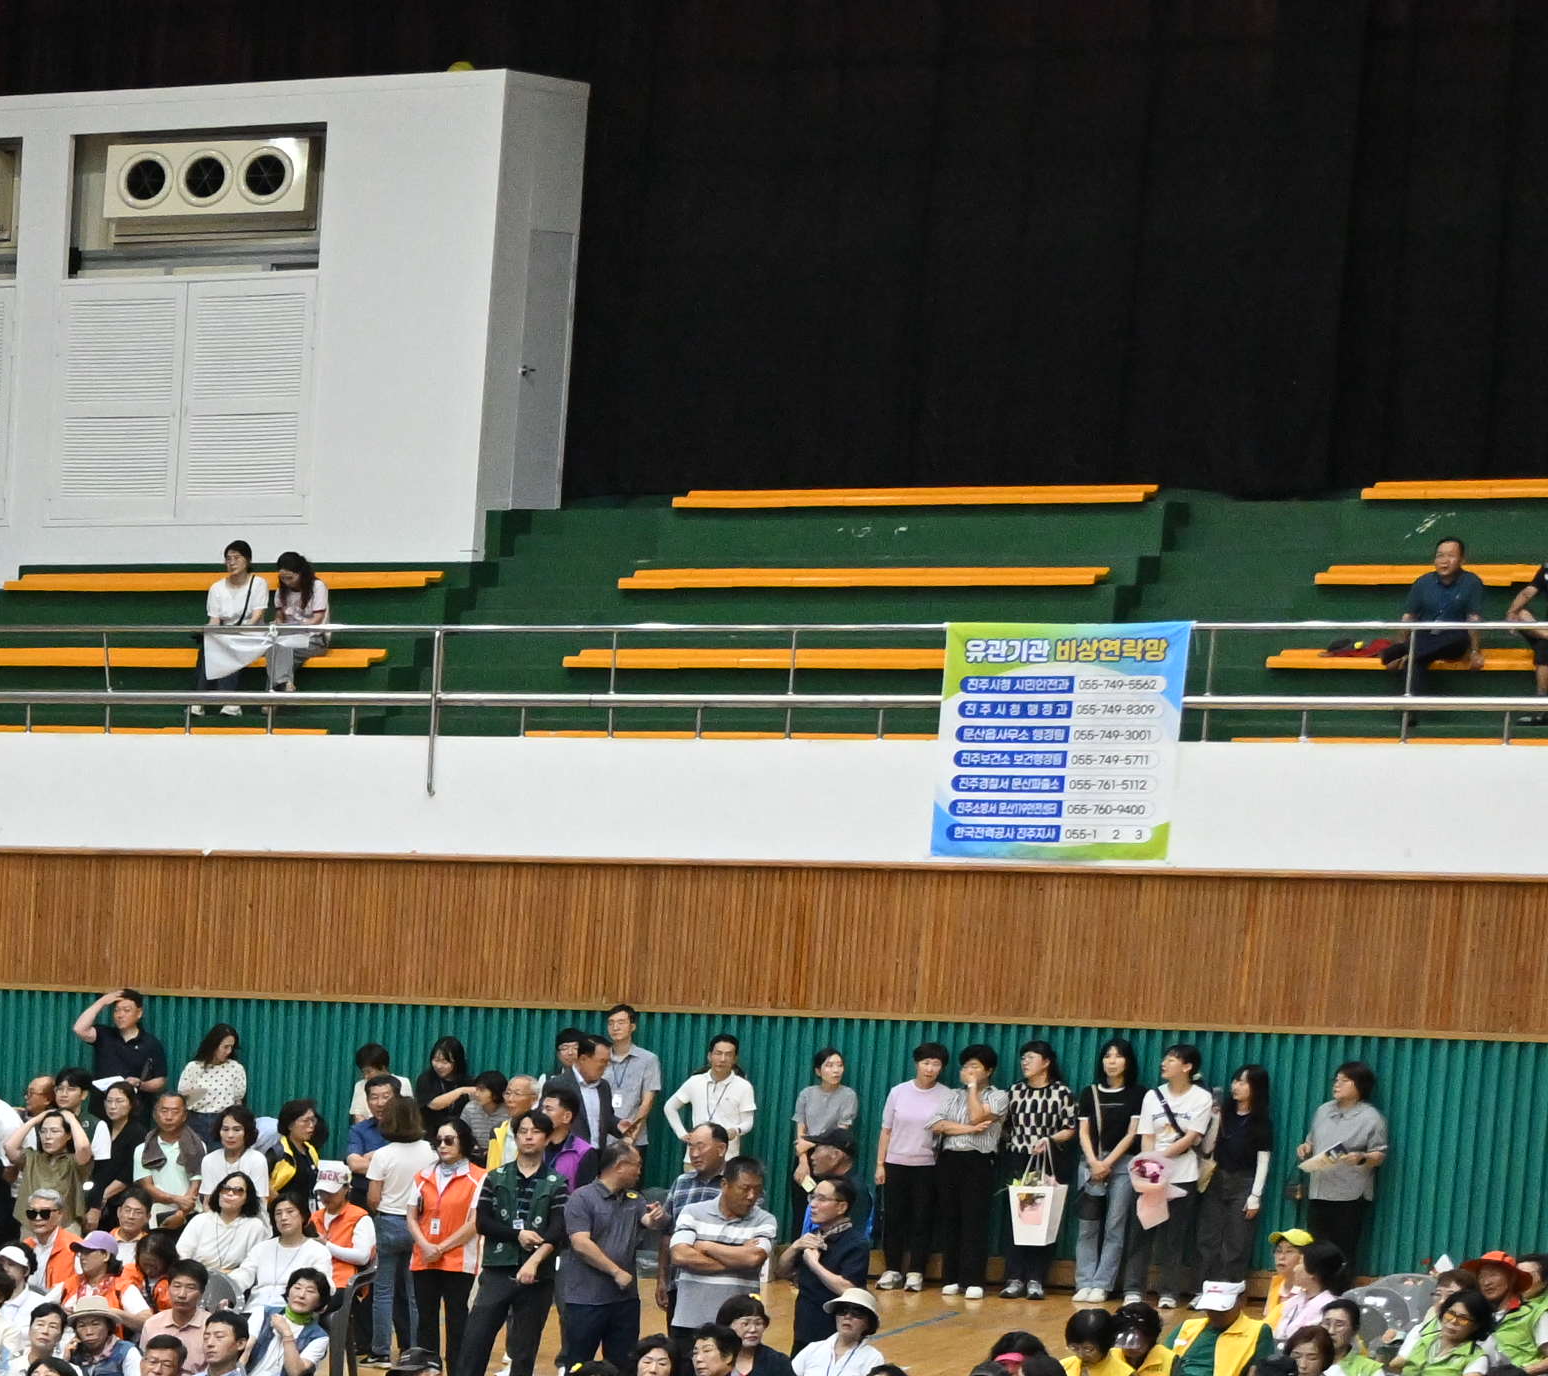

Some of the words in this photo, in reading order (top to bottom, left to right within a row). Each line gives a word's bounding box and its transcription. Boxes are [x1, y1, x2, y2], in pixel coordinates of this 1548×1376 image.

[965, 638, 1051, 663] 유관기관
[1055, 638, 1168, 662] 비상연락망
[967, 678, 1011, 692] 진주시청
[1078, 679, 1157, 691] 055-749-5562
[1076, 704, 1155, 715] 055-749-8309
[1073, 729, 1151, 741] 055-749-3001
[1071, 754, 1149, 766] 055-749-5711
[1068, 779, 1147, 791] 055-761-5112
[1066, 804, 1145, 815] 055-760-9400
